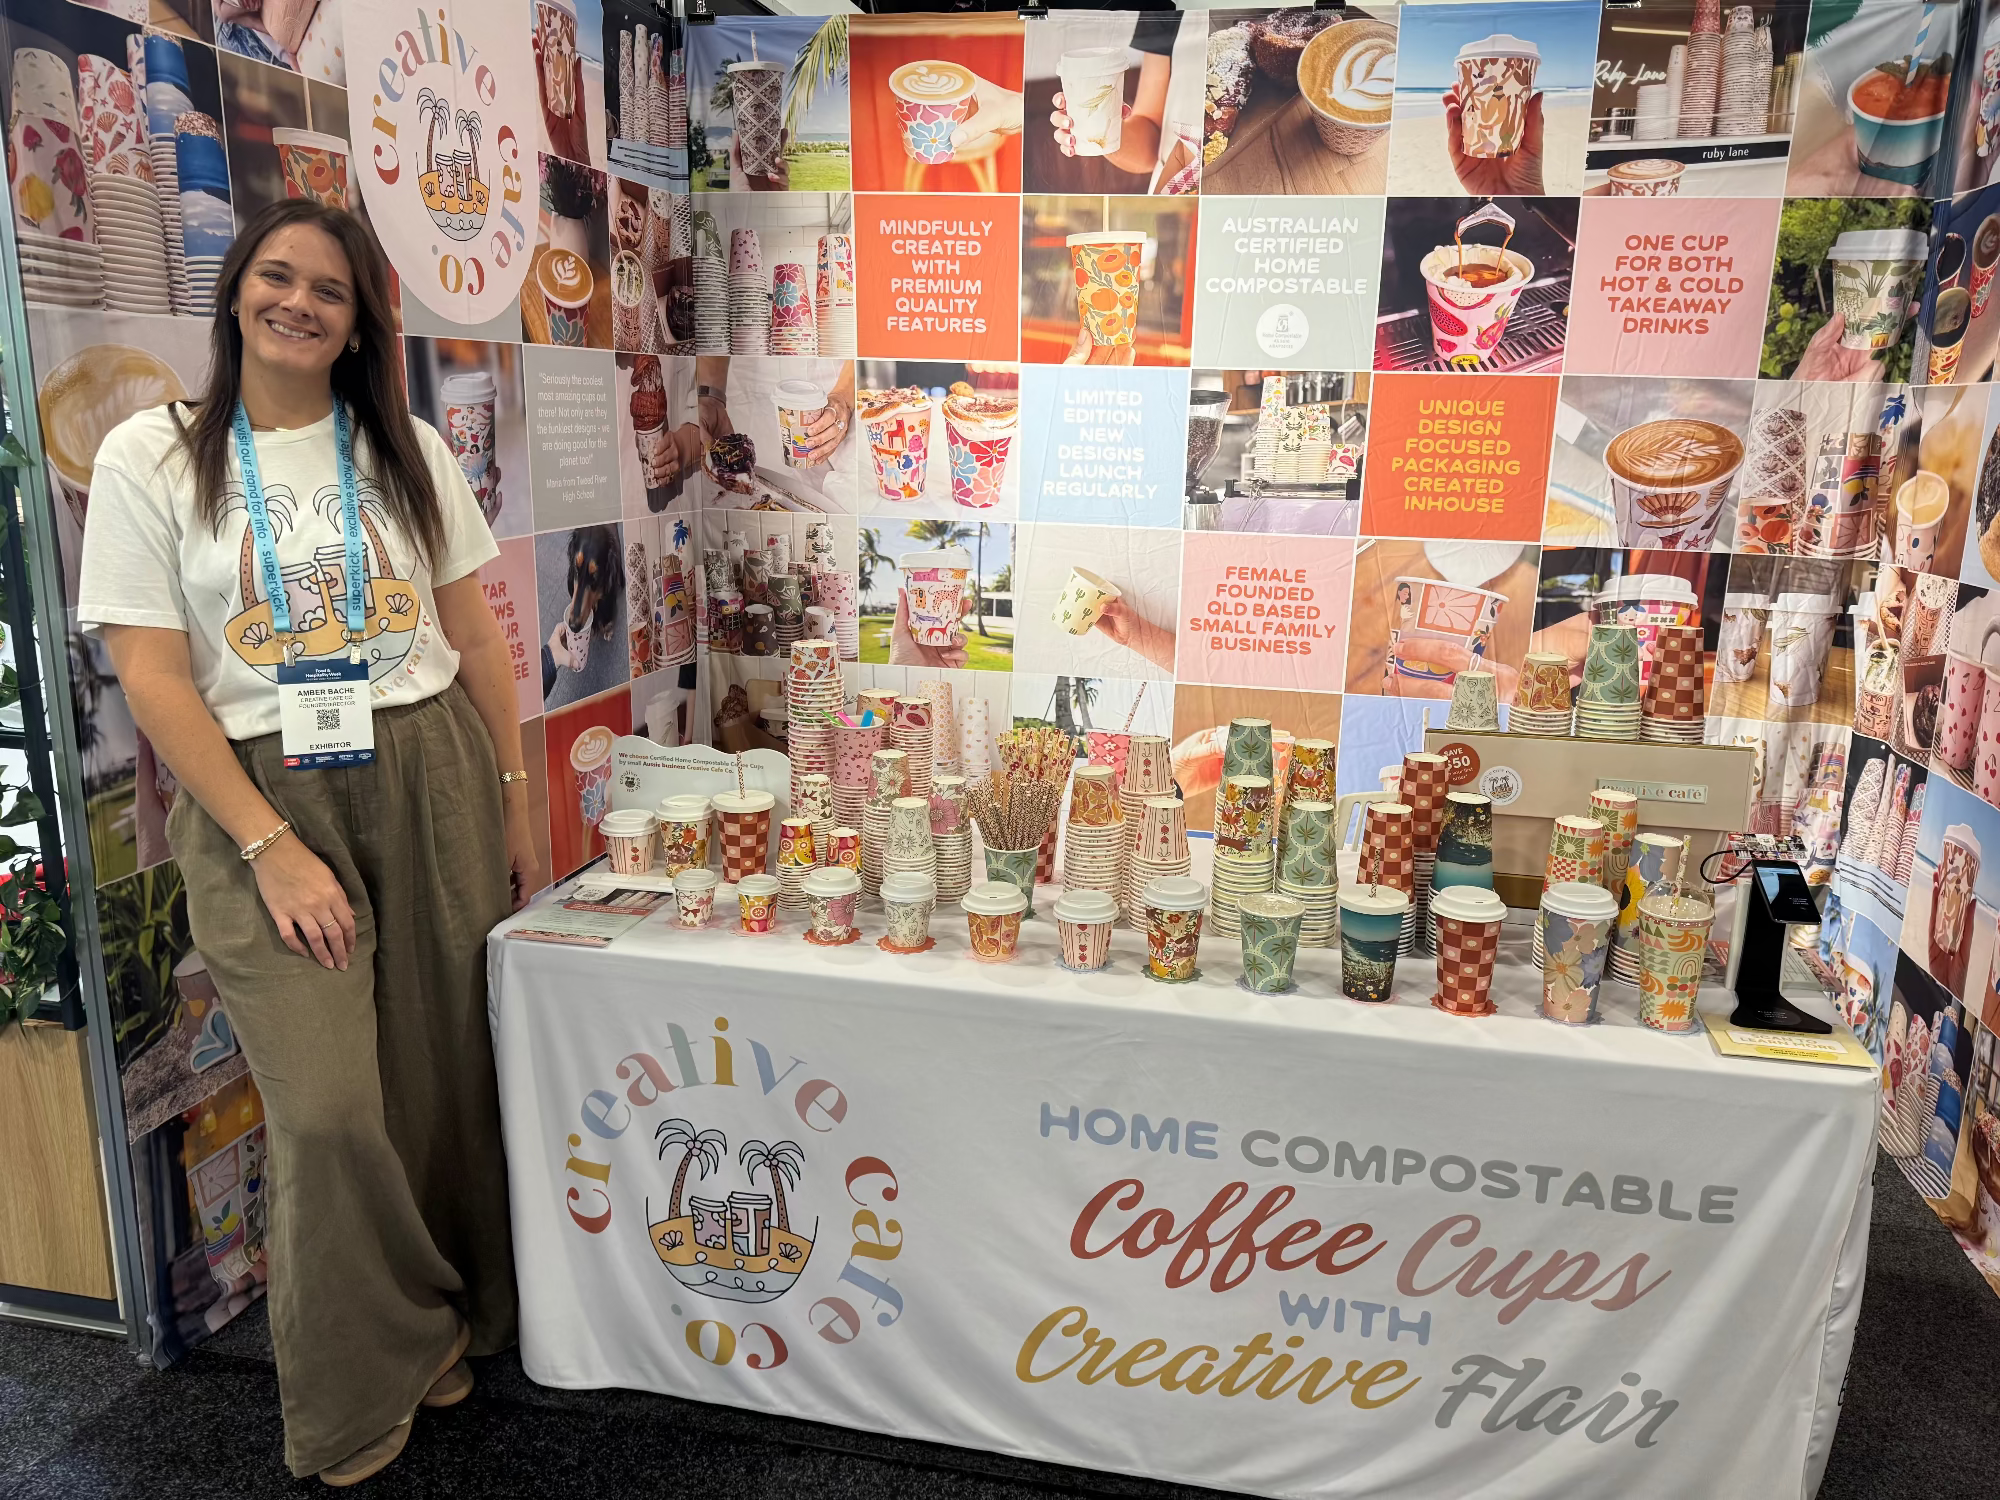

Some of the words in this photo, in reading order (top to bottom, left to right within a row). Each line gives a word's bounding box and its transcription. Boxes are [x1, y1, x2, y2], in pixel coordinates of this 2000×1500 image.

[1594, 59, 1627, 93] Ruby
[1630, 63, 1667, 85] Lane
[372, 7, 496, 185] creative
[1702, 149, 1726, 161] ruby
[1728, 146, 1750, 157] lane
[490, 125, 525, 268] cafe
[879, 220, 993, 236] MINDFULLY
[1221, 217, 1359, 234] AUSTRALIAN
[891, 239, 982, 256] CREATED
[1234, 237, 1344, 254] CERTIFIED
[1625, 234, 1675, 251] ONE
[1681, 235, 1729, 252] CUP
[911, 259, 960, 275] WITH
[1254, 257, 1321, 274] HOME
[1615, 255, 1662, 272] FOR
[1668, 256, 1733, 273] BOTH
[890, 278, 982, 295] PREMIUM
[1205, 277, 1368, 295] COMPOSTABLE
[1600, 276, 1649, 292] HOT
[1655, 276, 1672, 293] &
[1679, 277, 1744, 294] COLD
[895, 297, 978, 314] QUALITY
[1607, 296, 1731, 314] TAKEAWAY
[886, 316, 987, 333] FEATURES
[1622, 317, 1710, 335] DRINKS
[572, 375, 582, 385] the
[583, 375, 604, 386] coolest
[537, 392, 554, 401] most
[555, 390, 581, 403] amazing
[581, 393, 596, 403] cups
[596, 393, 606, 401] out
[1064, 389, 1143, 407] LIMITED
[538, 406, 557, 418] there!
[558, 406, 570, 418] Not
[570, 407, 584, 419] only
[584, 408, 594, 417] are
[594, 407, 608, 419] they
[1063, 407, 1142, 425] EDITION
[1419, 399, 1505, 416] UNIQUE
[536, 423, 548, 434] the
[548, 423, 574, 434] funkiest
[574, 423, 597, 435] designs
[1079, 427, 1125, 443] NEW
[1418, 418, 1502, 436] DESIGN
[237, 427, 250, 446] visit
[542, 441, 553, 451] are
[553, 439, 572, 452] doing
[572, 438, 588, 452] good
[588, 438, 597, 448] for
[597, 438, 608, 448] the
[339, 438, 351, 463] offer
[1057, 444, 1145, 463] DESIGNS
[1405, 438, 1511, 456] FOCUSED
[241, 448, 252, 467] our
[559, 456, 579, 469] planet
[1391, 457, 1521, 475] PACKAGING
[342, 466, 355, 493] show
[1059, 463, 1143, 481] LAUNCH
[244, 469, 262, 499] stand
[563, 477, 576, 488] from
[1043, 480, 1158, 500] REGULARLY
[1403, 476, 1504, 494] CREATED
[562, 491, 576, 503] High
[576, 489, 595, 500] School
[1404, 495, 1505, 513] INHOUSE
[250, 500, 262, 517] for
[345, 494, 359, 538] exclusive
[254, 518, 267, 539] info
[262, 550, 286, 614] superkick
[348, 551, 361, 611] superkick
[1225, 566, 1307, 583] FEMALE
[1216, 583, 1315, 601] FOUNDED
[1207, 601, 1248, 616] QLD
[1252, 603, 1321, 620] BASED
[1189, 617, 1257, 635] SMALL
[1262, 621, 1336, 639] FAMILY
[1210, 636, 1312, 655] BUSINESS
[297, 689, 326, 697] AMBER
[327, 687, 355, 695] BACHE
[309, 742, 352, 750] EXHIBITOR
[1443, 747, 1464, 757] SAVE
[661, 762, 686, 770] business
[686, 764, 710, 772] Creative
[692, 759, 730, 767] Compostable
[1668, 788, 1702, 800] café
[1740, 1037, 1790, 1047] LEARN
[1793, 1041, 1837, 1051] MORE
[1750, 1033, 1792, 1042] SCAN
[565, 1016, 848, 1234] creative
[1039, 1101, 1220, 1160] HOME
[1240, 1129, 1739, 1224] COMPOSTABLE
[808, 1156, 904, 1344] cafe
[1069, 1178, 1388, 1293] Coffee
[1396, 1214, 1672, 1325] Cups
[1279, 1290, 1432, 1345] WITH
[1015, 1306, 1423, 1410] Creative
[1434, 1354, 1679, 1448] Flair
